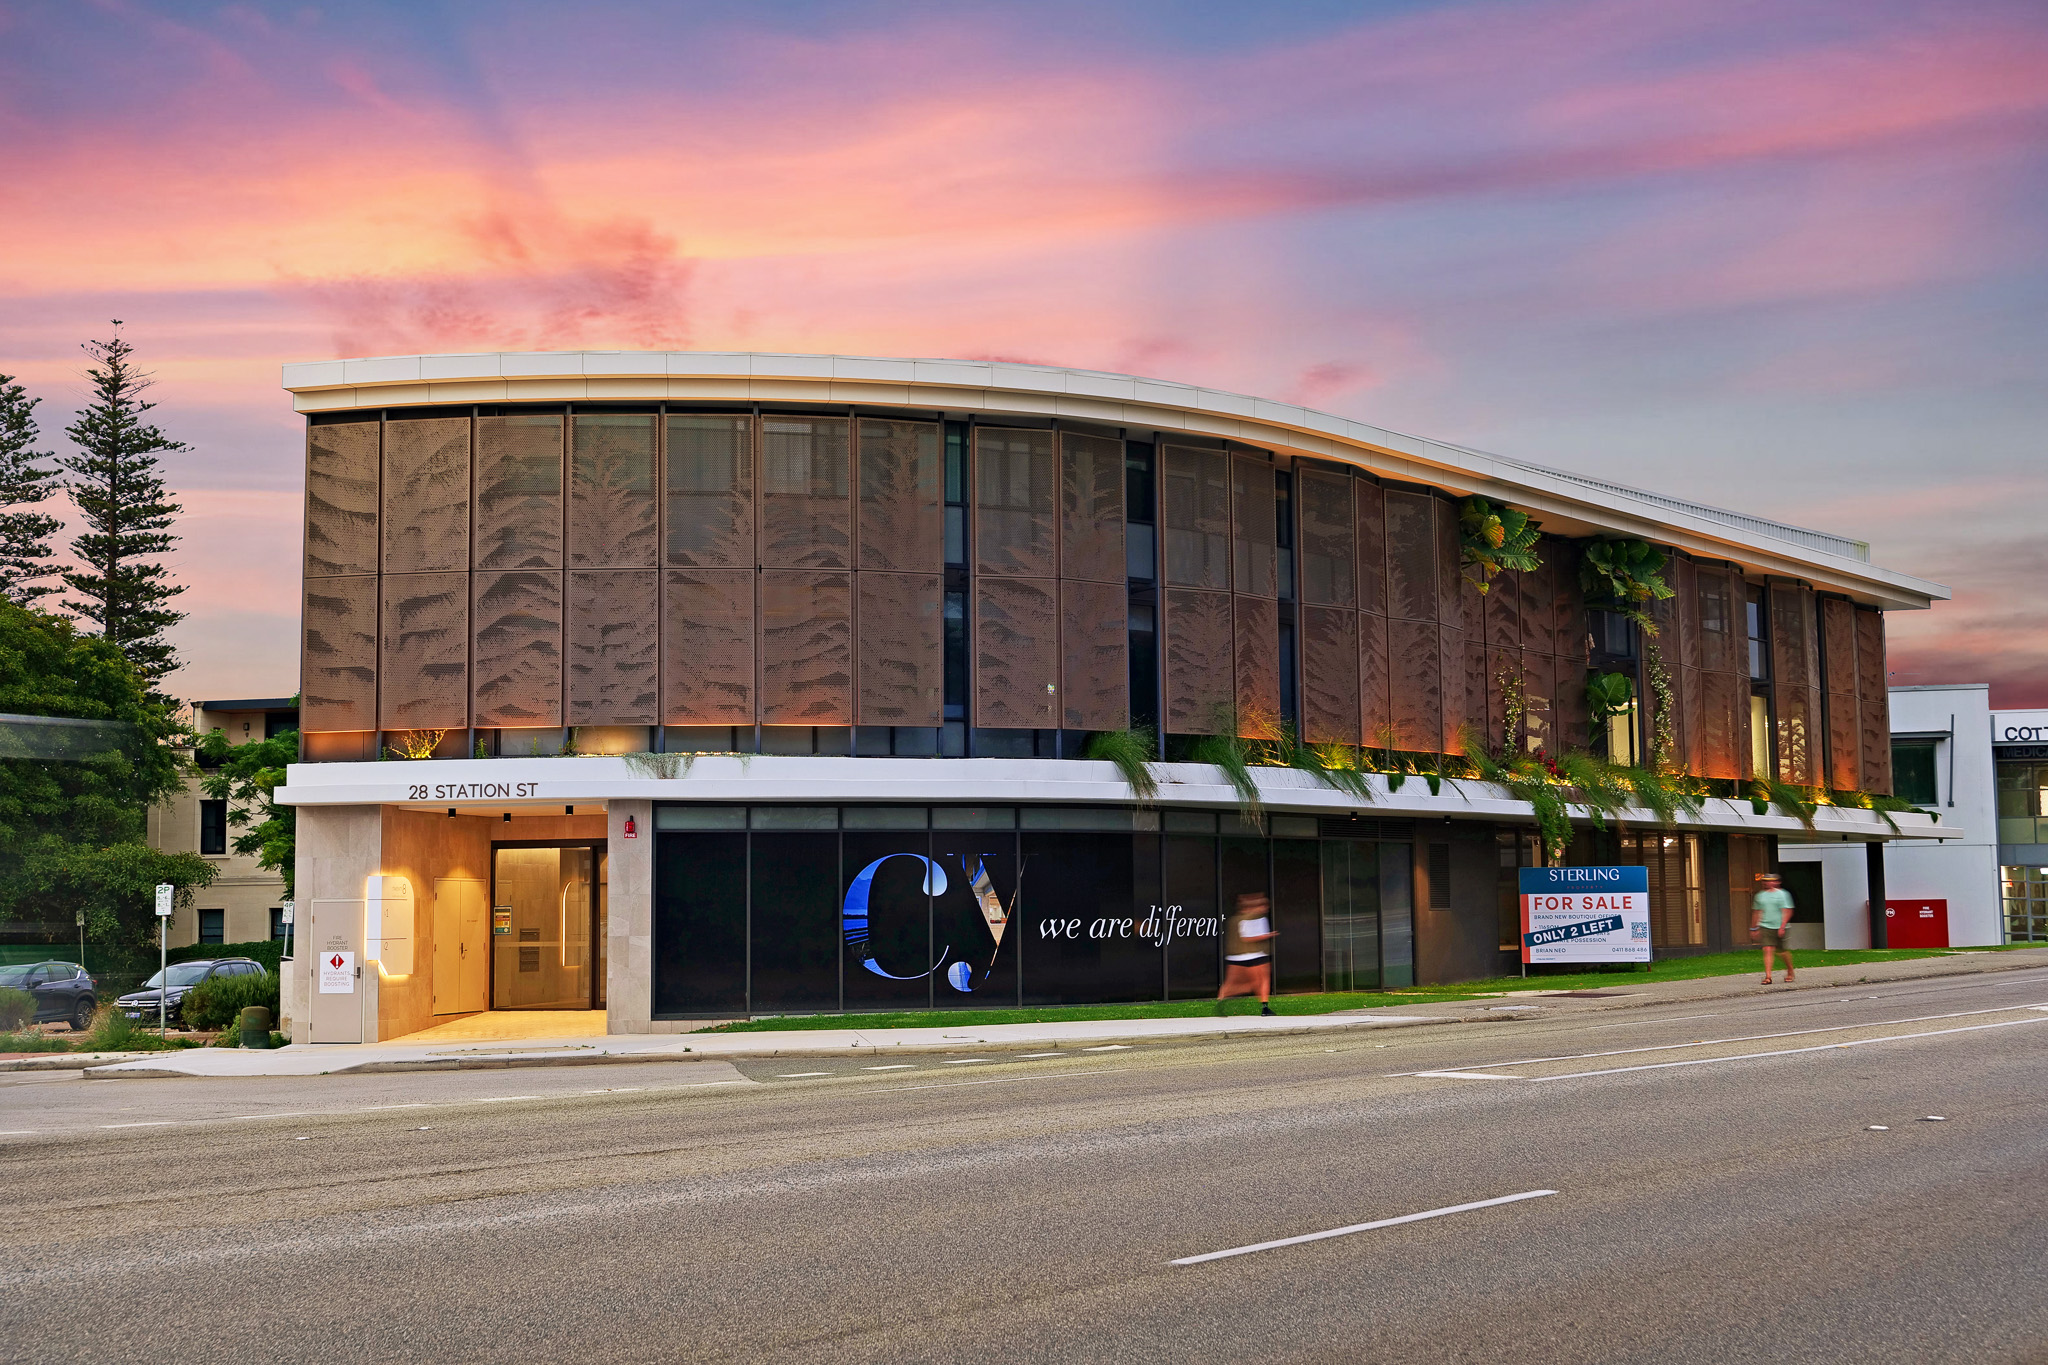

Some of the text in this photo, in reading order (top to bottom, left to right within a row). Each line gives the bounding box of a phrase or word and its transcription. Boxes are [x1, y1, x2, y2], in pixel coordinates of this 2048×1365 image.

[409, 783, 538, 799] 28 STATION ST
[1549, 869, 1620, 881] STERLING
[157, 886, 170, 894] 2P
[1534, 896, 1632, 911] FOR SALE
[1039, 917, 1081, 940] we
[1089, 917, 1133, 939] are
[1533, 919, 1613, 944] ONLY 2 LEFT
